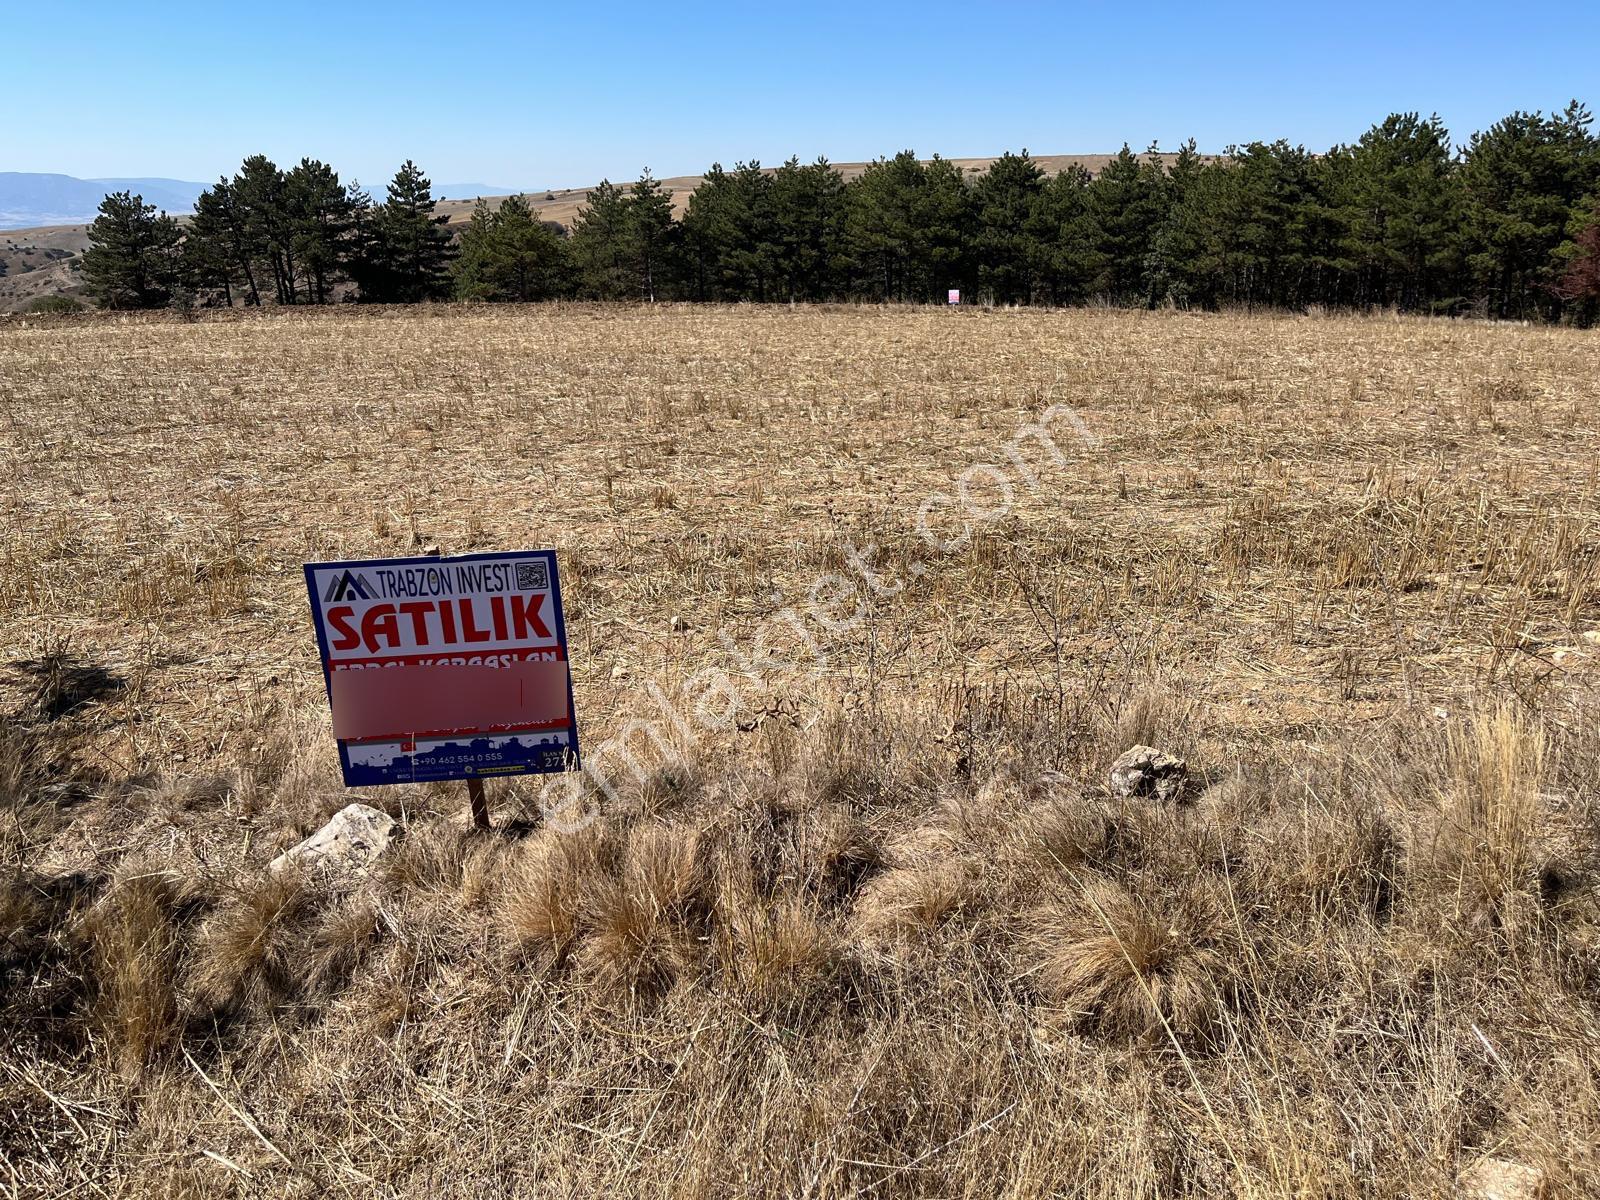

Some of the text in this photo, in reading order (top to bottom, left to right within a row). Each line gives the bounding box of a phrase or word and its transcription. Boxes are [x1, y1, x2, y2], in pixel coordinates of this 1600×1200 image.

[376, 563, 511, 599] TRABZON INVEST
[327, 594, 553, 654] SATILIK
[438, 756, 455, 764] 462
[457, 755, 475, 763] 554
[477, 754, 482, 762] 0
[485, 753, 503, 761] 555
